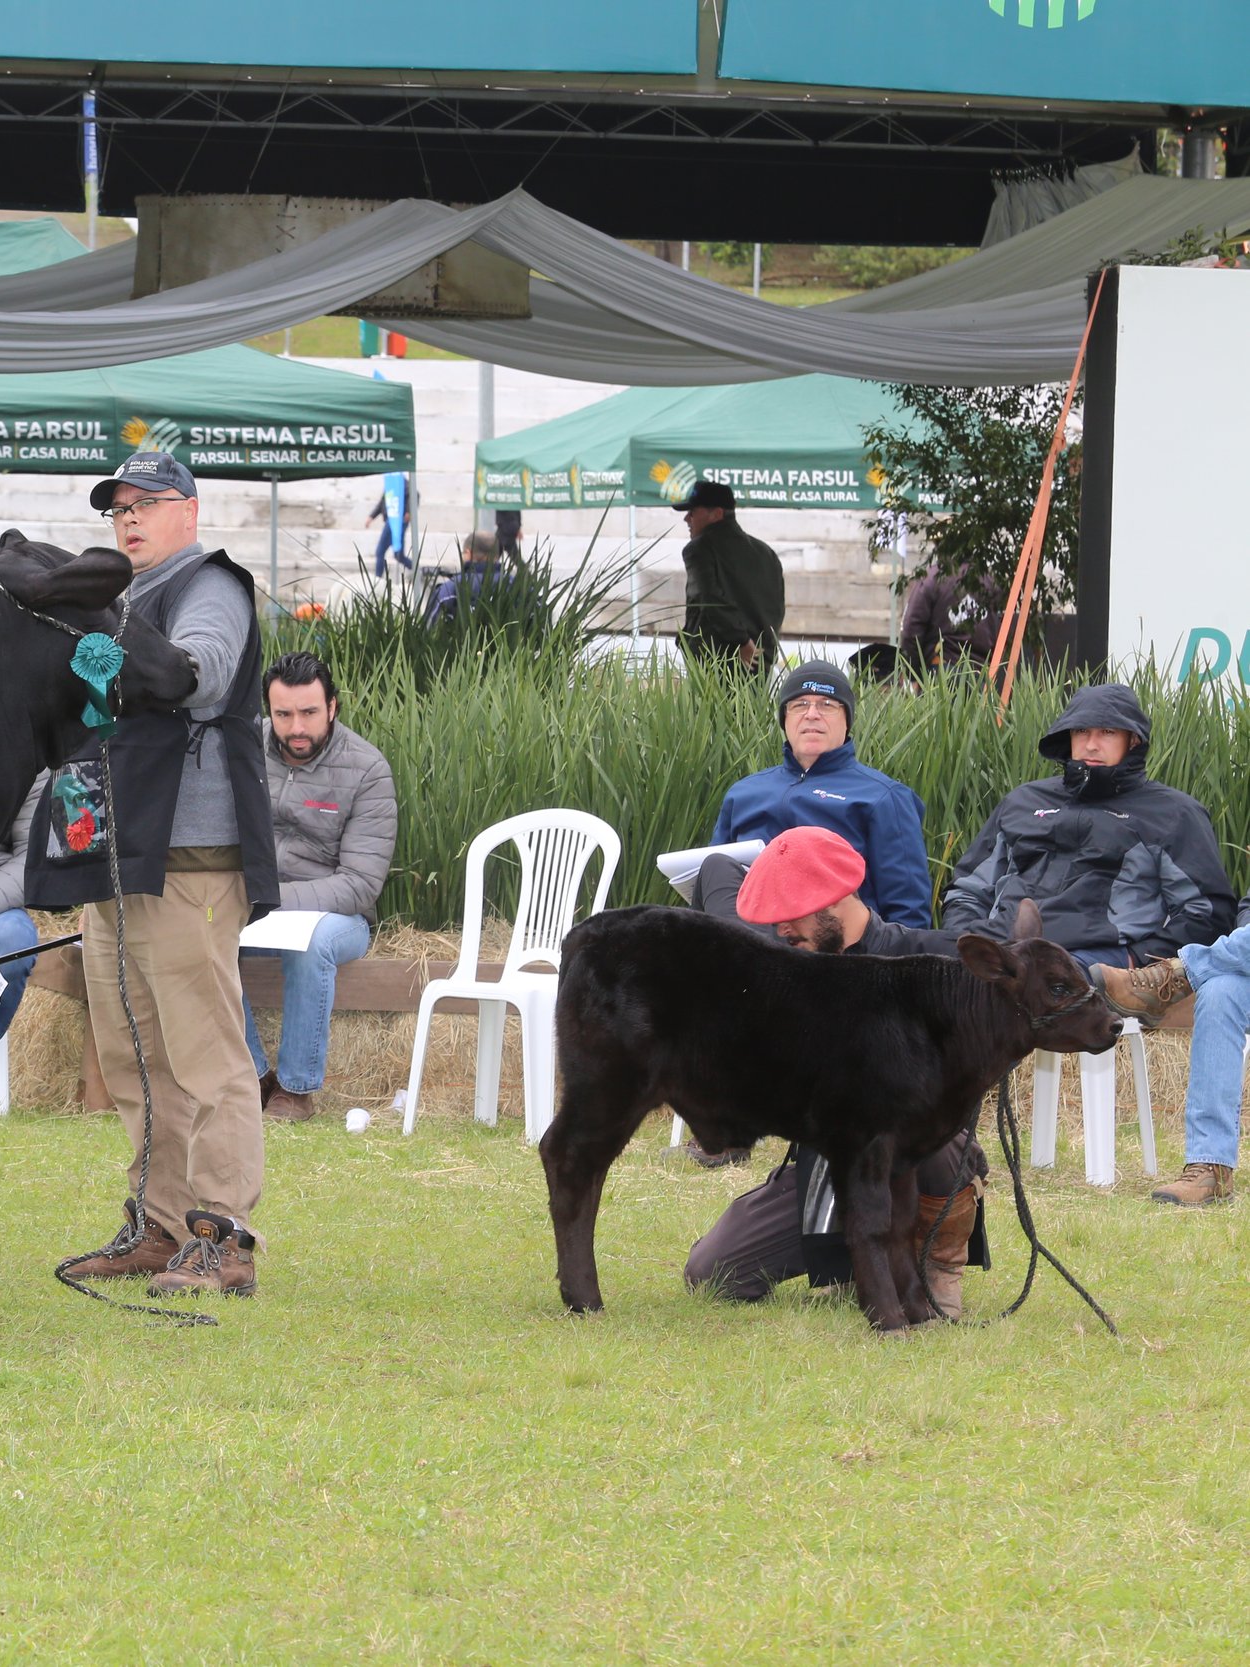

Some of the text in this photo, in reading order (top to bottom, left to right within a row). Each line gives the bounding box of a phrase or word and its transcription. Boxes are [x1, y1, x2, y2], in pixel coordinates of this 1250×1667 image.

[14, 421, 108, 441] FARSUL
[190, 424, 393, 445] SISTEMA FARSUL
[19, 446, 57, 460] CASA
[60, 447, 108, 460] RURAL
[191, 450, 394, 464] FARSUL SENAR CASA RURAL
[703, 468, 859, 486] SISTEMA FARSUL
[749, 490, 787, 501] SENAR
[792, 491, 821, 502] CASA
[824, 491, 860, 502] RURAL
